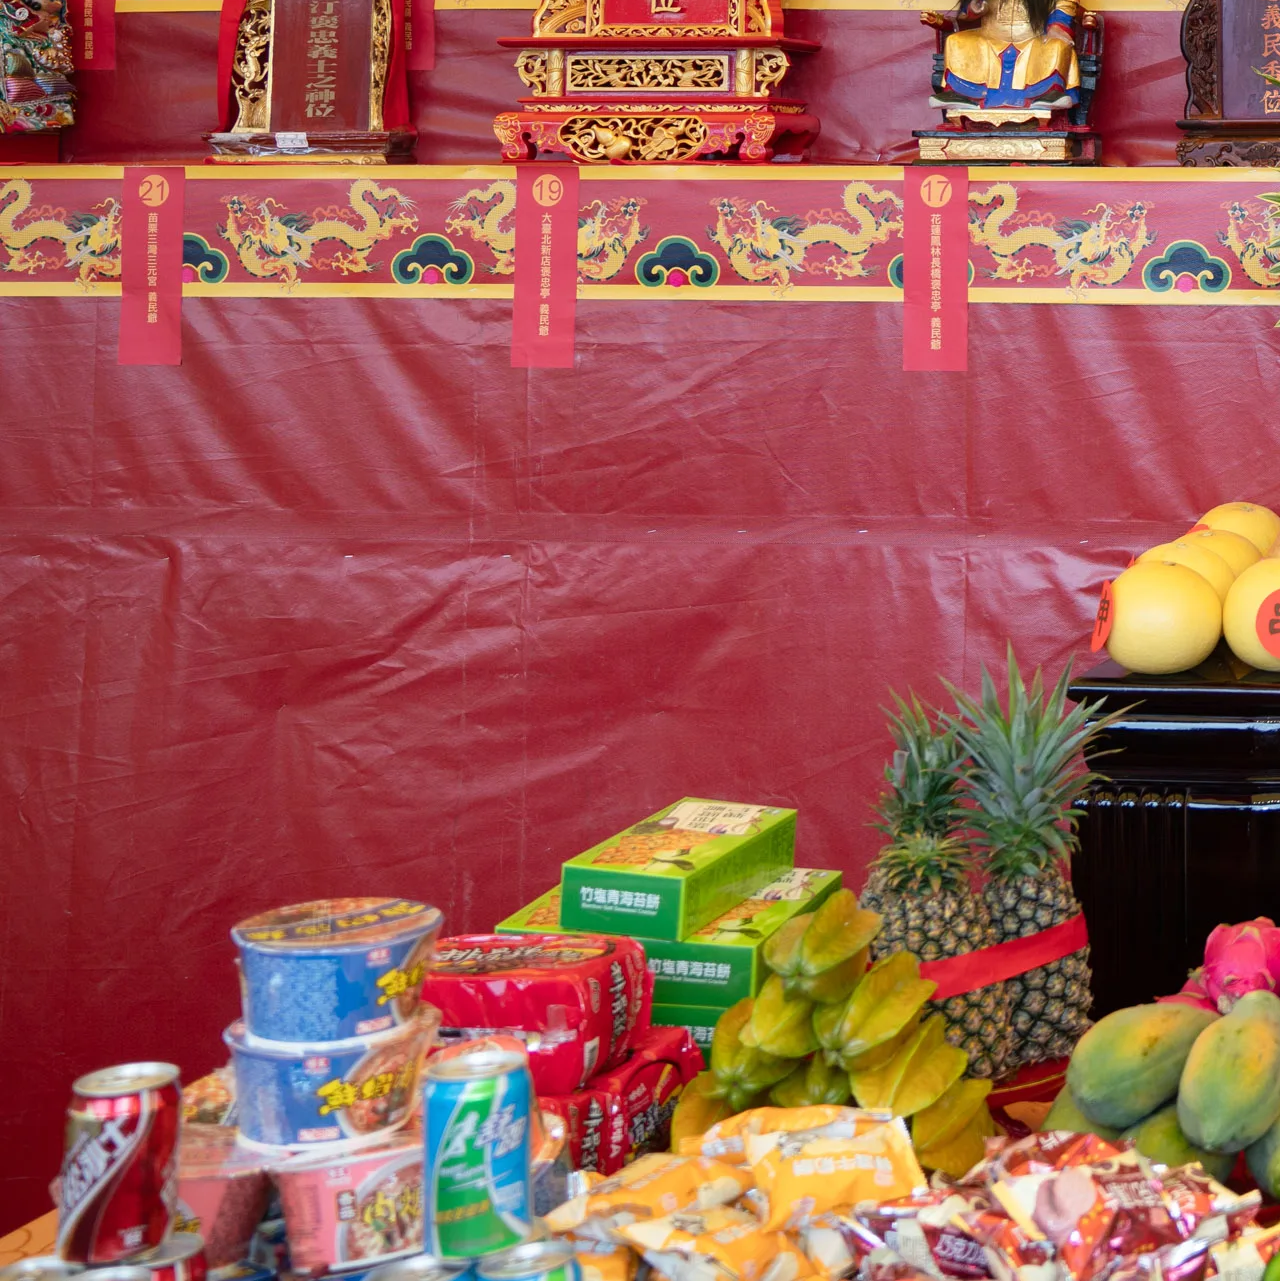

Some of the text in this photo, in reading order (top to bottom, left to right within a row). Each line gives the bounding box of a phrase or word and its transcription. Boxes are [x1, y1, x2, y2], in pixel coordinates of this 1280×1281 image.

[139, 180, 165, 202] 21
[535, 179, 562, 201] 19
[923, 180, 950, 202] 17
